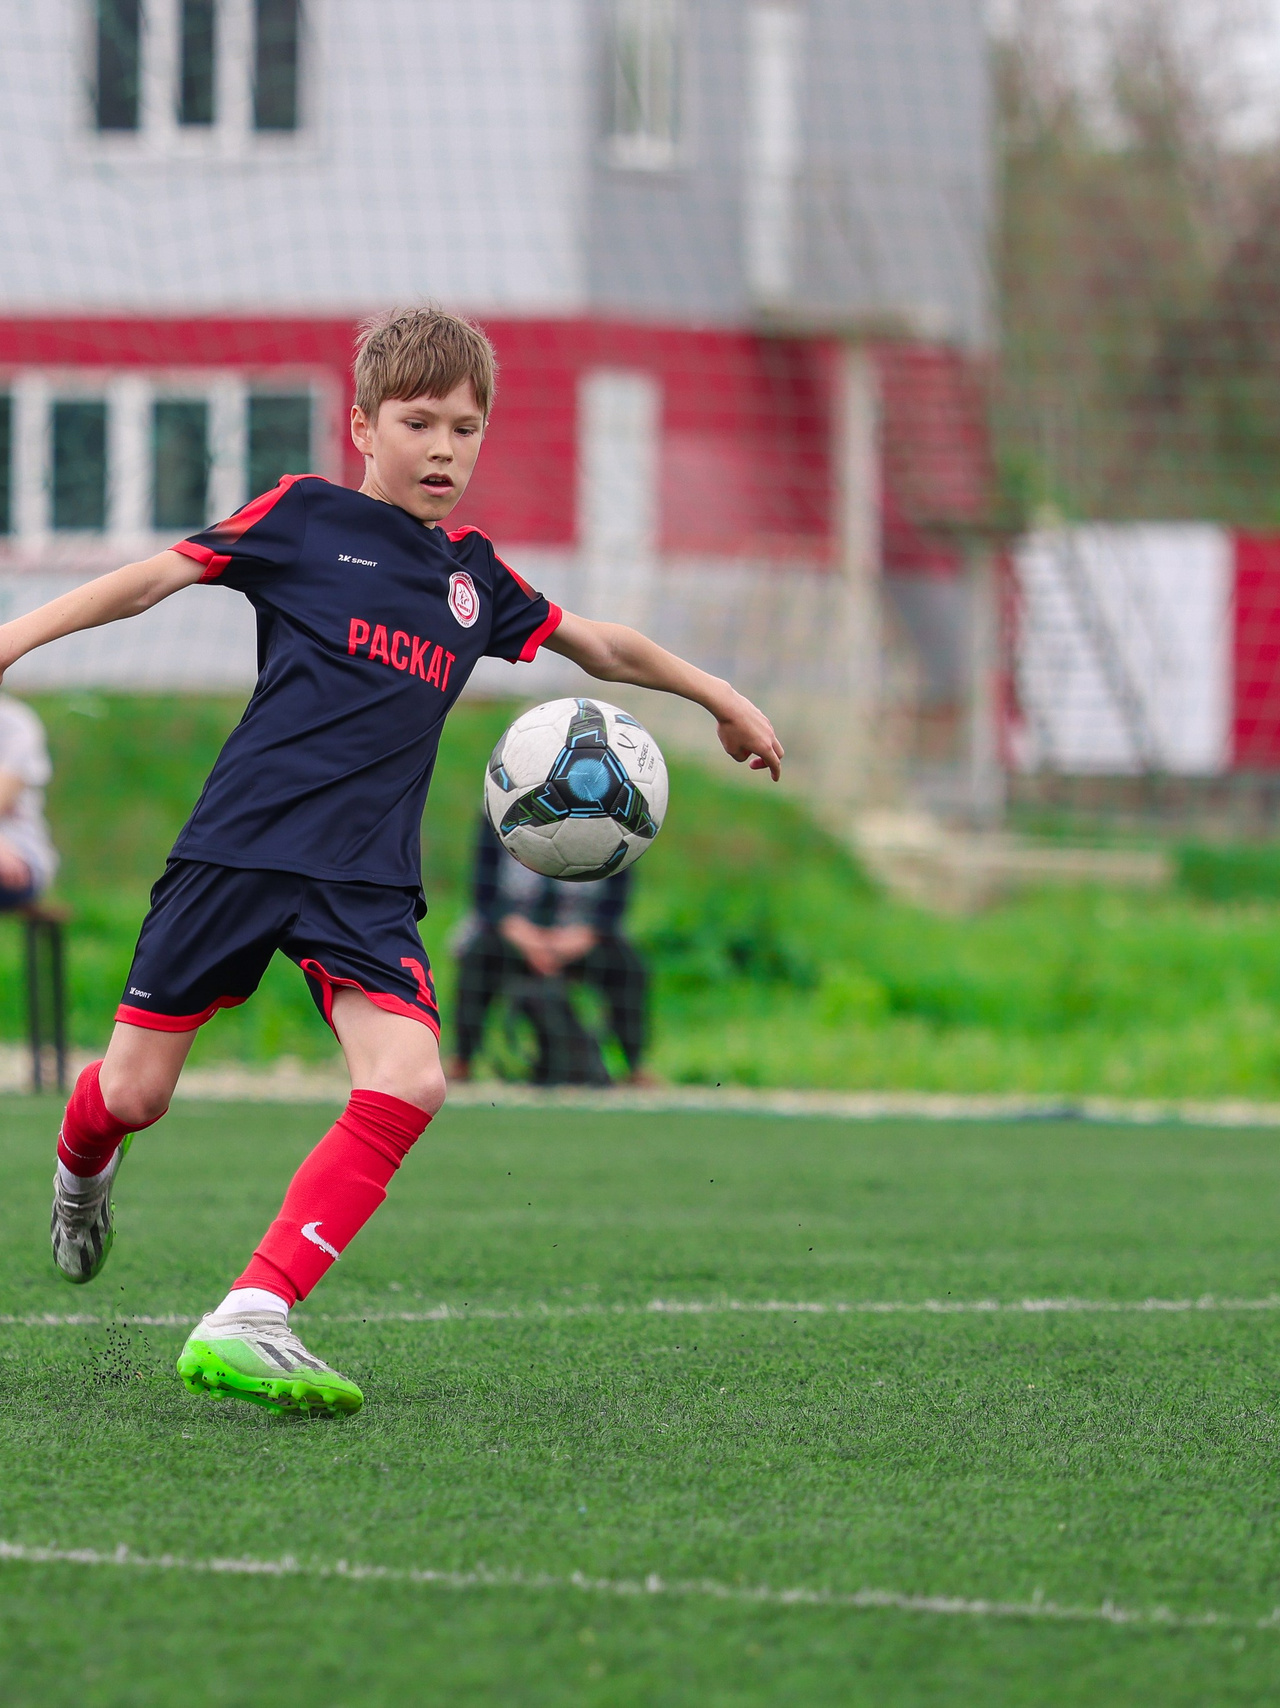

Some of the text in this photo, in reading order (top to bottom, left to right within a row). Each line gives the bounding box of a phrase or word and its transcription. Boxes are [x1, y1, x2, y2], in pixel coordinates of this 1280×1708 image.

[337, 553, 378, 568] 2K SPORT
[347, 618, 456, 692] РАСКАТ
[134, 990, 152, 999] SPORT
